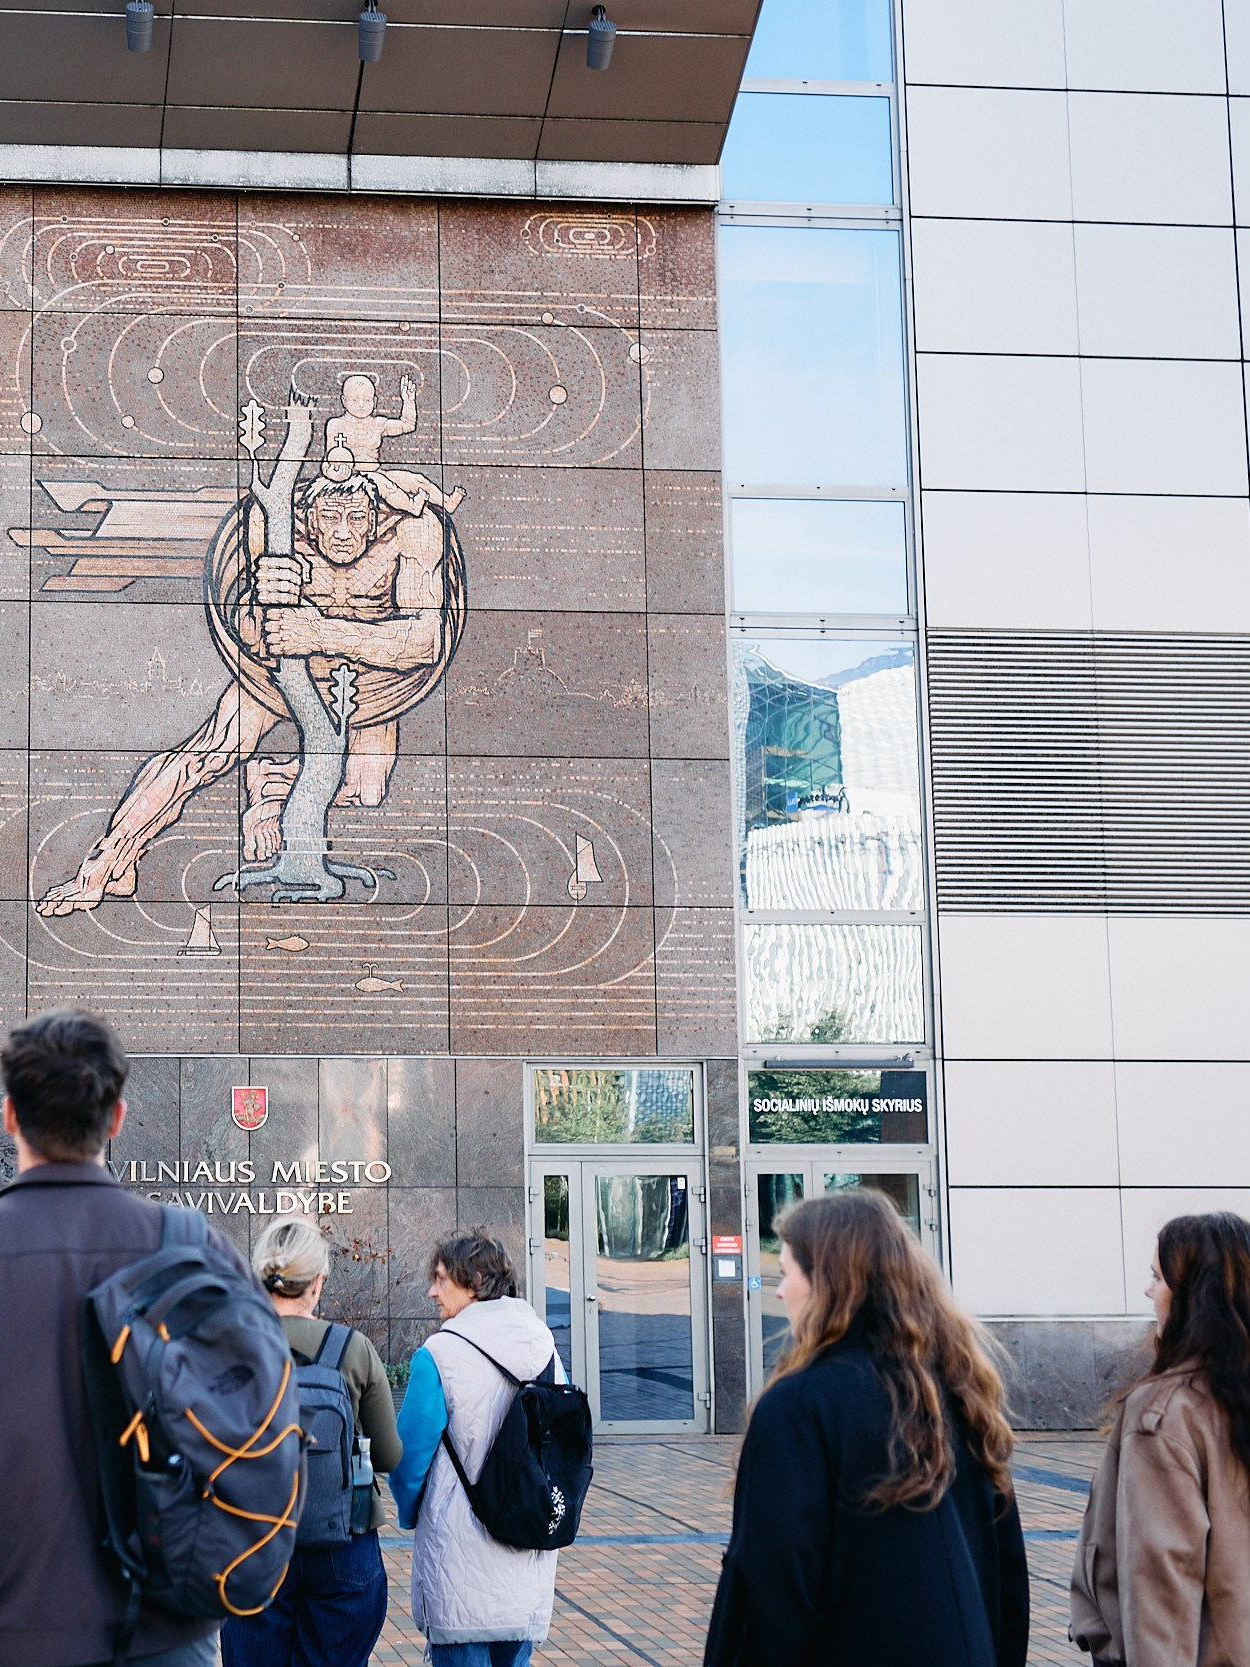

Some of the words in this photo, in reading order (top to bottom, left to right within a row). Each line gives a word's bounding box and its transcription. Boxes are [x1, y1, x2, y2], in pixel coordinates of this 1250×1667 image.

[753, 1098, 820, 1115] SOCIALINIŲ
[822, 1096, 870, 1116] IŠMOKŲ
[872, 1098, 923, 1113] SKYRIUS
[107, 1160, 257, 1183] VILNIAUS
[271, 1160, 392, 1183] MIESTO
